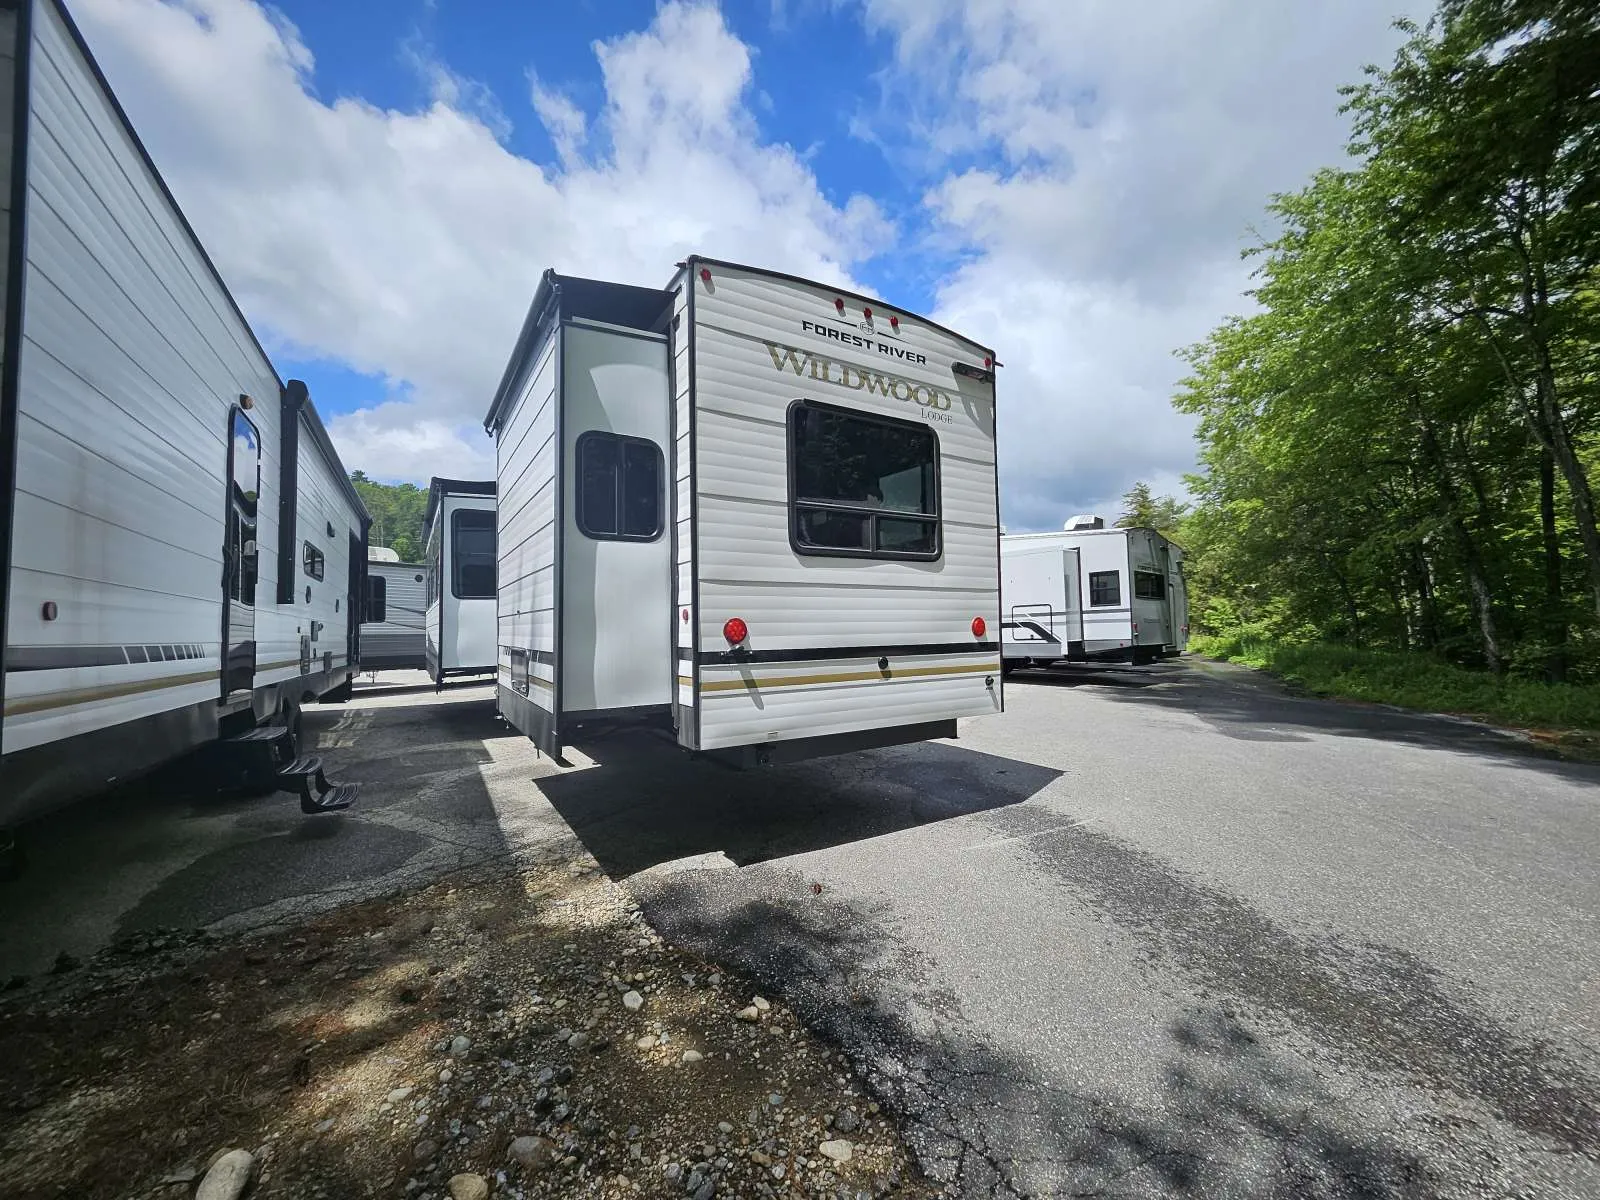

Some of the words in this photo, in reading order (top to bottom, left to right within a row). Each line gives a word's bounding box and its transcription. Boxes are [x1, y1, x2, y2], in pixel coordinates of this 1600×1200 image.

[802, 320, 873, 349] FOREST
[878, 342, 926, 365] RIVER
[764, 341, 951, 411] WILDWOOD
[921, 408, 952, 425] LODGE
